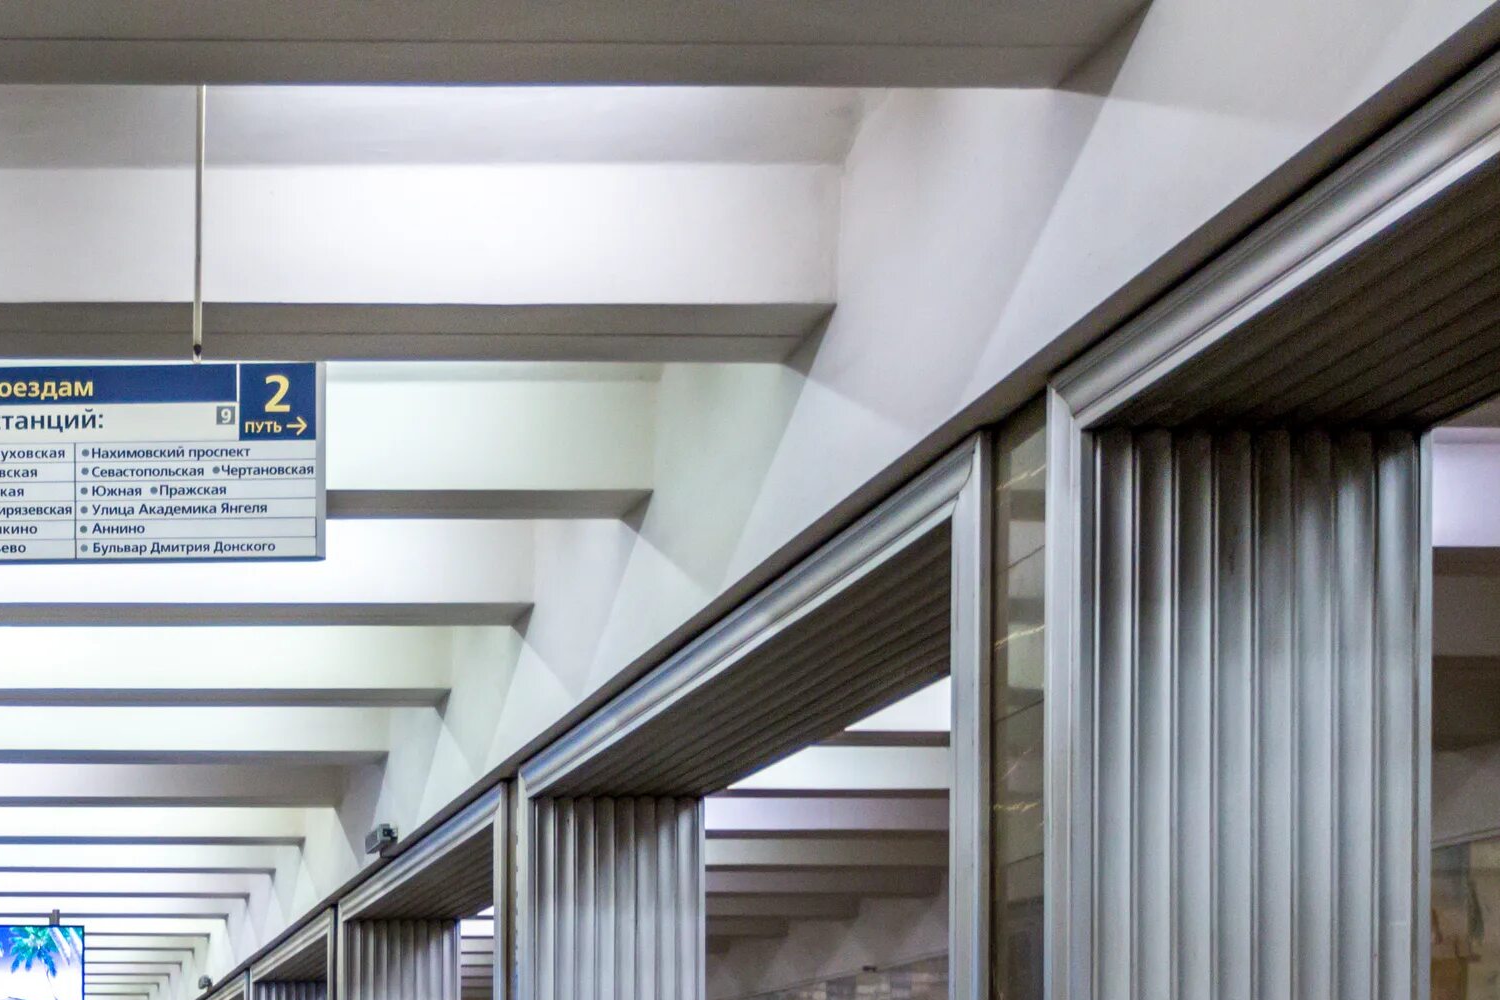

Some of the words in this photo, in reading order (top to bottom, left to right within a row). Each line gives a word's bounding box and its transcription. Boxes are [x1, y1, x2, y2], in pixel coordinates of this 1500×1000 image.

[264, 374, 290, 412] 2
[221, 409, 231, 423] 9
[245, 421, 282, 433] ПУТЬ
[91, 446, 185, 459] Нахимовский
[189, 448, 251, 461] проспект
[91, 466, 205, 478] Севастопольская
[221, 465, 314, 478] Чертановская
[91, 485, 142, 497] Южная
[159, 484, 227, 499] Пражская
[92, 504, 135, 516] Улица
[138, 504, 217, 516] Академика
[221, 502, 268, 514] Янгеля
[92, 522, 145, 534] Аннино
[93, 542, 148, 556] Бульвар
[150, 542, 210, 555] Дмитрия
[213, 541, 276, 554] Донского
